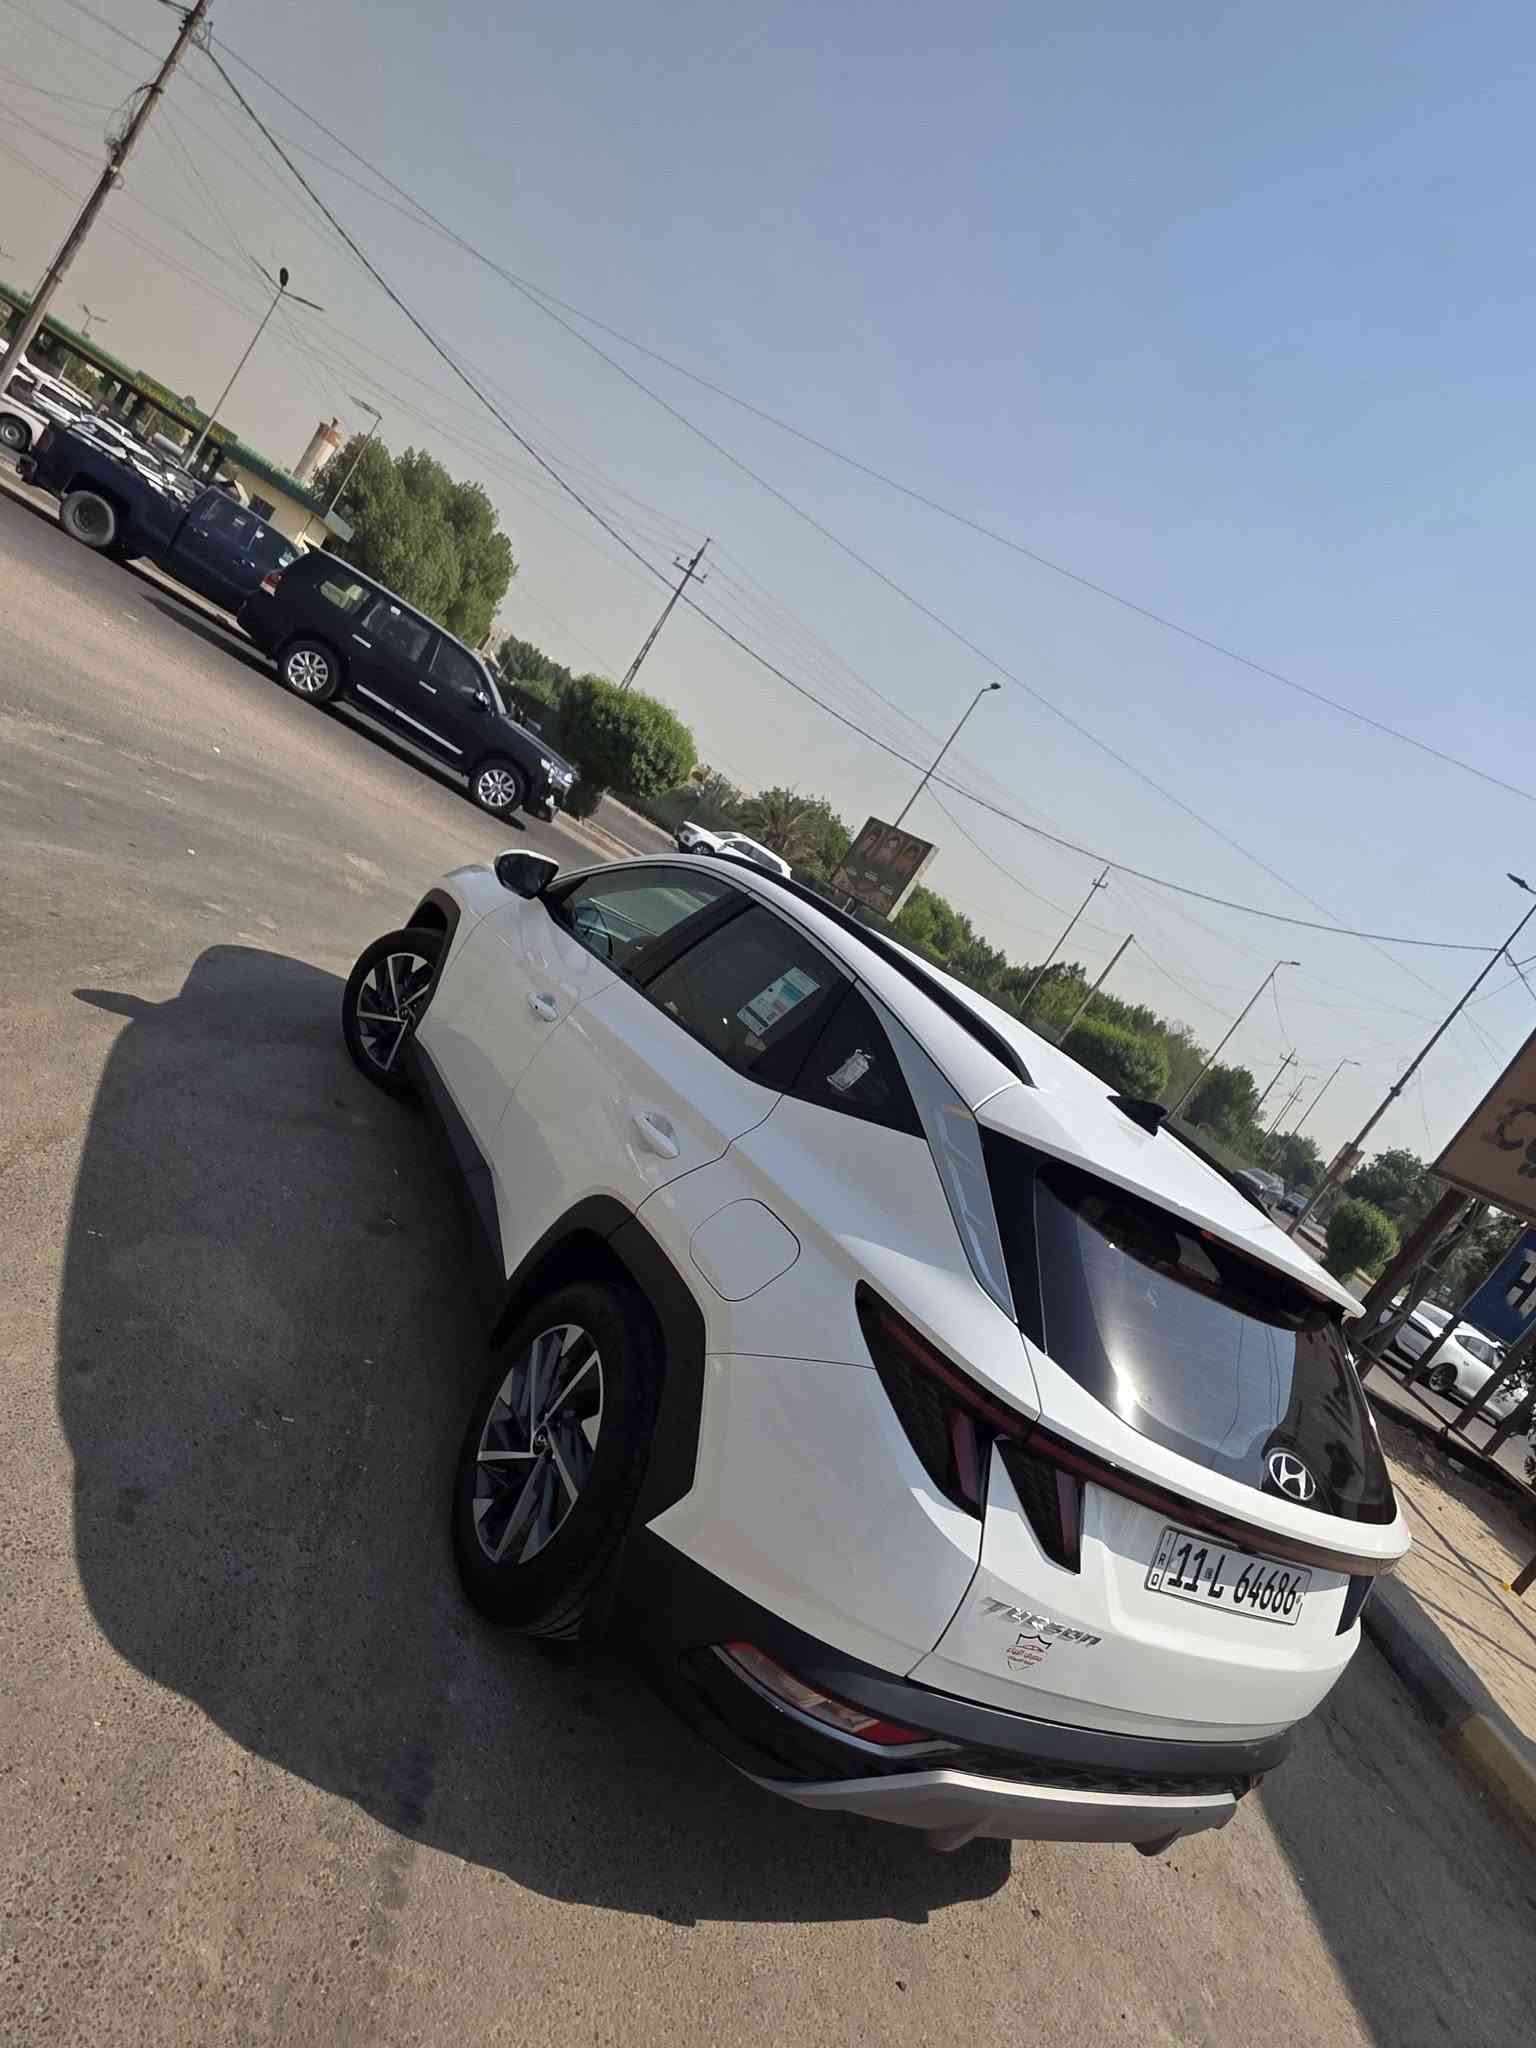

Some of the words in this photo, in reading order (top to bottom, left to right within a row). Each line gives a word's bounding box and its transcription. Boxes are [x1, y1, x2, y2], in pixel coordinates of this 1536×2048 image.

[1167, 1543, 1208, 1592] 11
[1208, 1554, 1225, 1598] L
[1233, 1563, 1301, 1615] 64686
